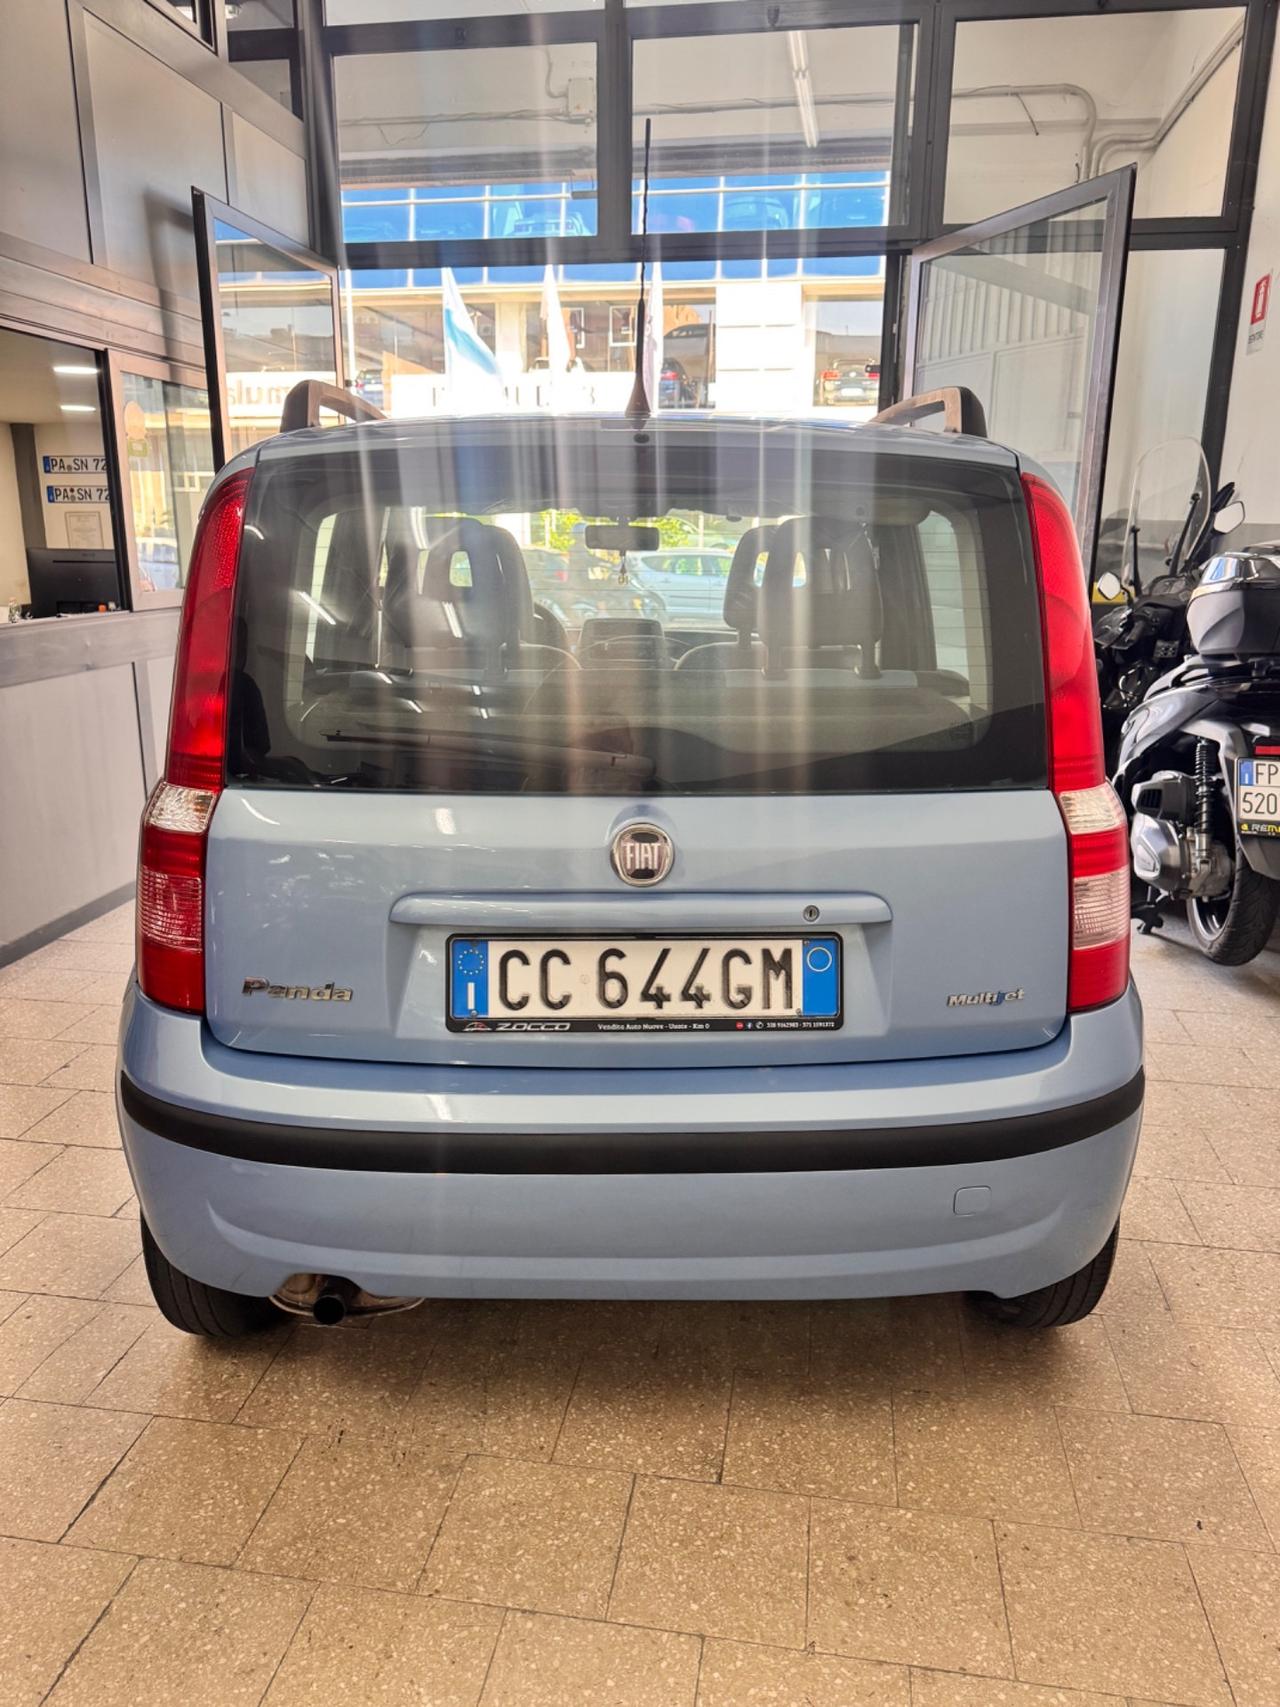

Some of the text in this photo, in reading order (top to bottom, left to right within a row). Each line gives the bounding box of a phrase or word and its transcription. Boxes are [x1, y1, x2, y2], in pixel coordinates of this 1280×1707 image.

[73, 458, 88, 471] SN
[76, 487, 92, 501] SN
[1255, 763, 1279, 784] FP
[1242, 791, 1278, 815] 520
[624, 842, 662, 870] FIAT
[241, 976, 354, 1002] Panda
[495, 1022, 571, 1032] ZOCCO
